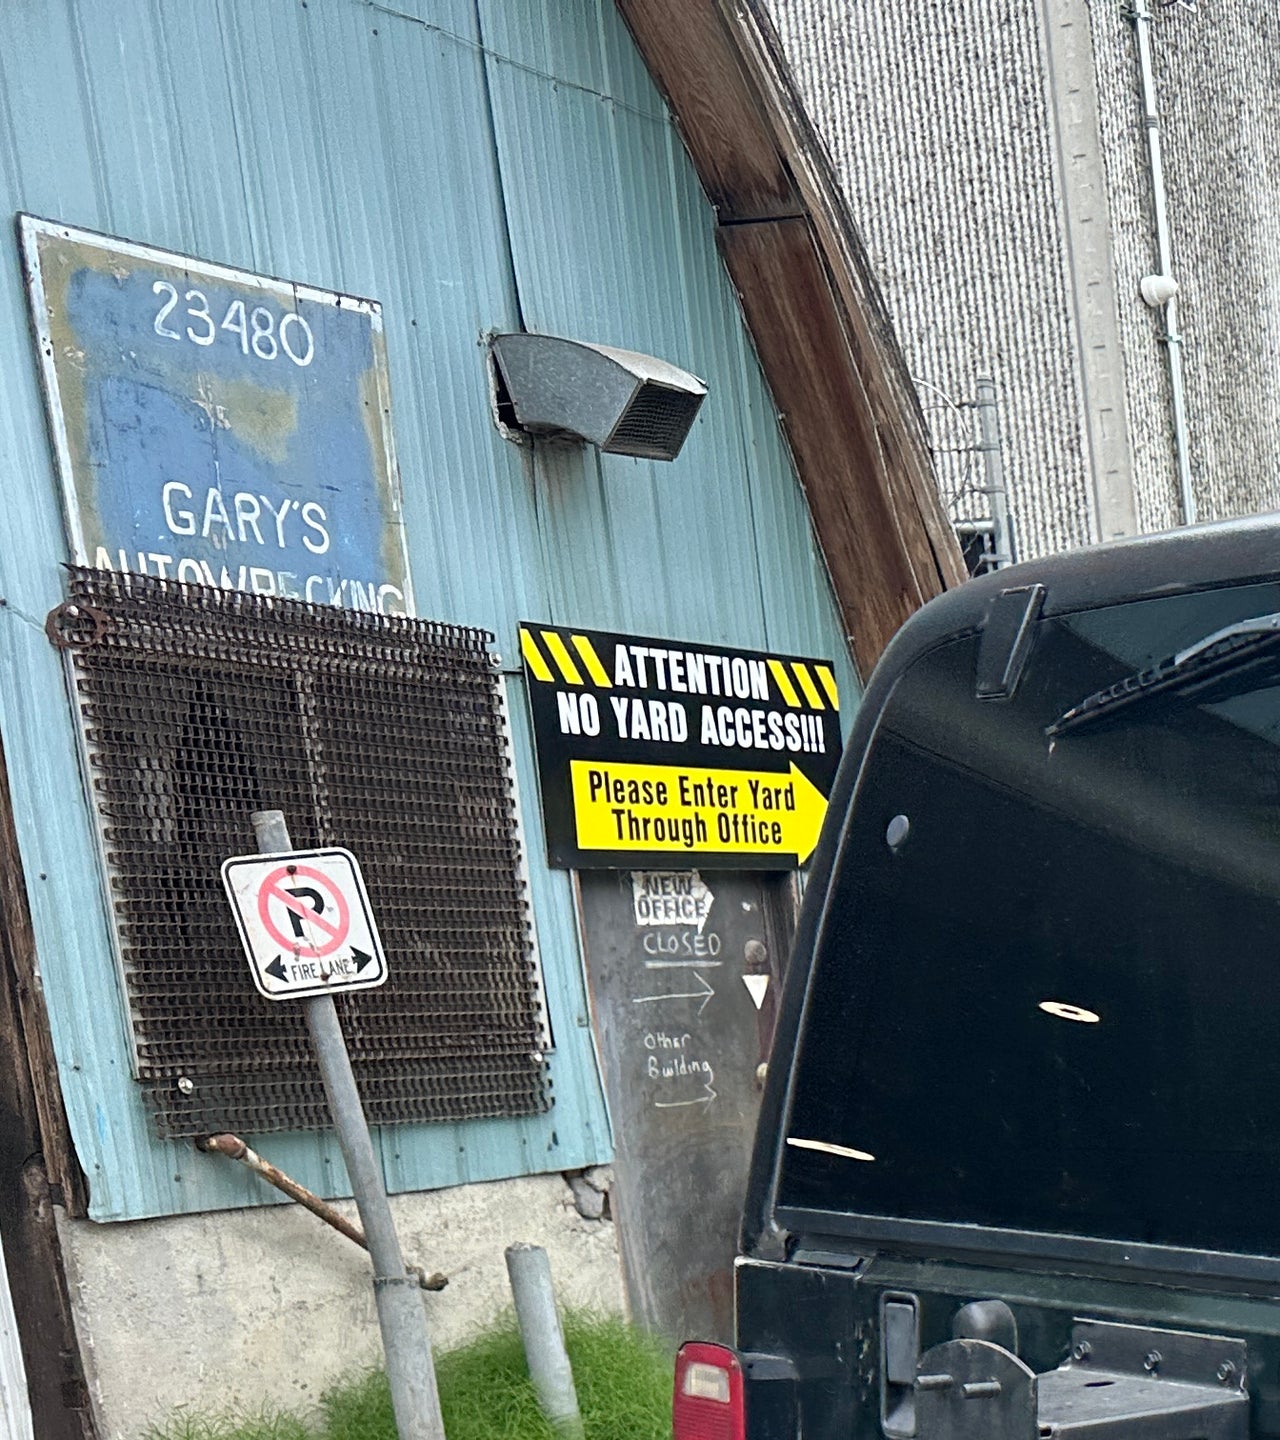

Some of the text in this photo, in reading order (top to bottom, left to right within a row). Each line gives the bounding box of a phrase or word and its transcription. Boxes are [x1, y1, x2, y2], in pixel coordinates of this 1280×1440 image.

[152, 280, 314, 367] 23480
[162, 481, 331, 555] GARY'S
[614, 644, 769, 701] ATTENTION
[556, 691, 826, 754] NO YARD ACCESS!!!
[588, 770, 796, 812] Please Enter Yard
[611, 809, 782, 848] Through Office
[643, 875, 692, 895] NEW
[638, 895, 706, 918] OFFICE
[643, 932, 720, 956] CLOSED
[291, 958, 354, 981] FIRE LANE
[644, 1032, 691, 1049] Other
[648, 1054, 714, 1084] Building
